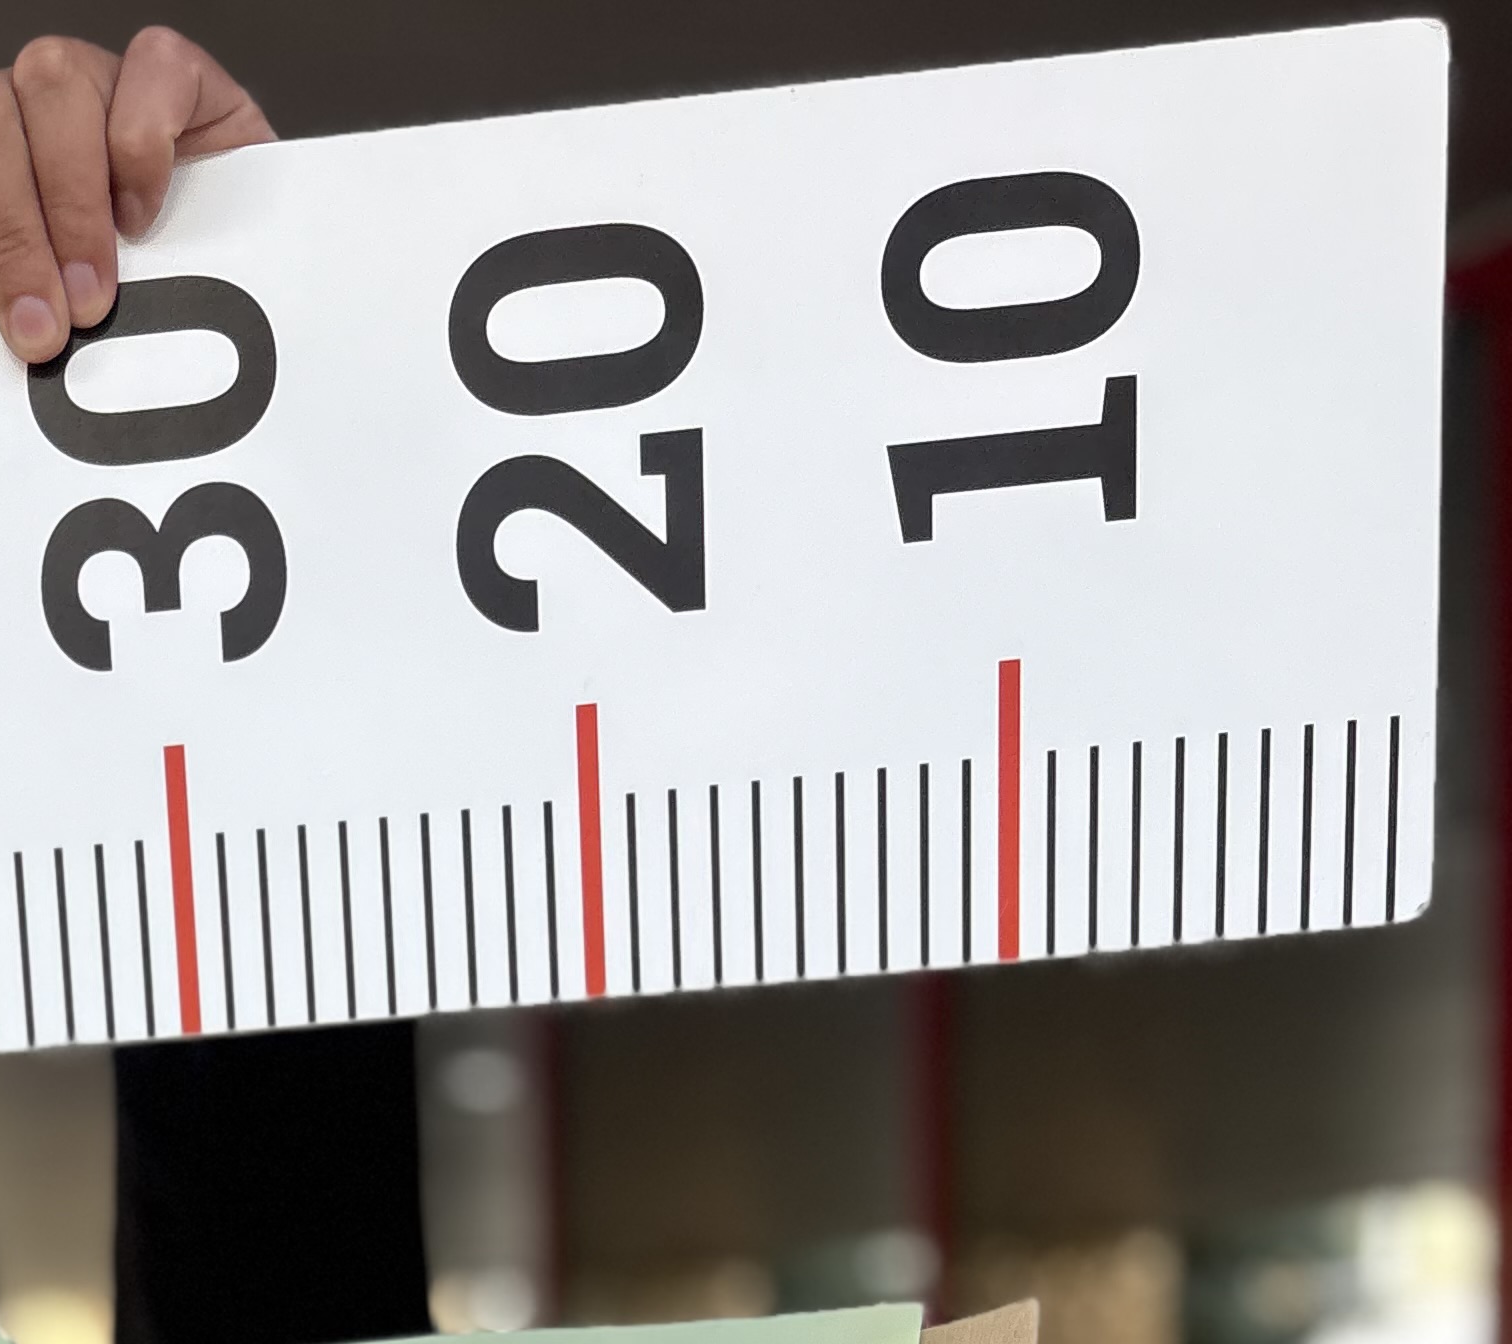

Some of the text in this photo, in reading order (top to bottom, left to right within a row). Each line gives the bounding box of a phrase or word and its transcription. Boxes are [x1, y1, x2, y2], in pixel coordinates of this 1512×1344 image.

[26, 275, 287, 671] 30
[448, 222, 706, 632] 20
[880, 171, 1141, 544] 10
